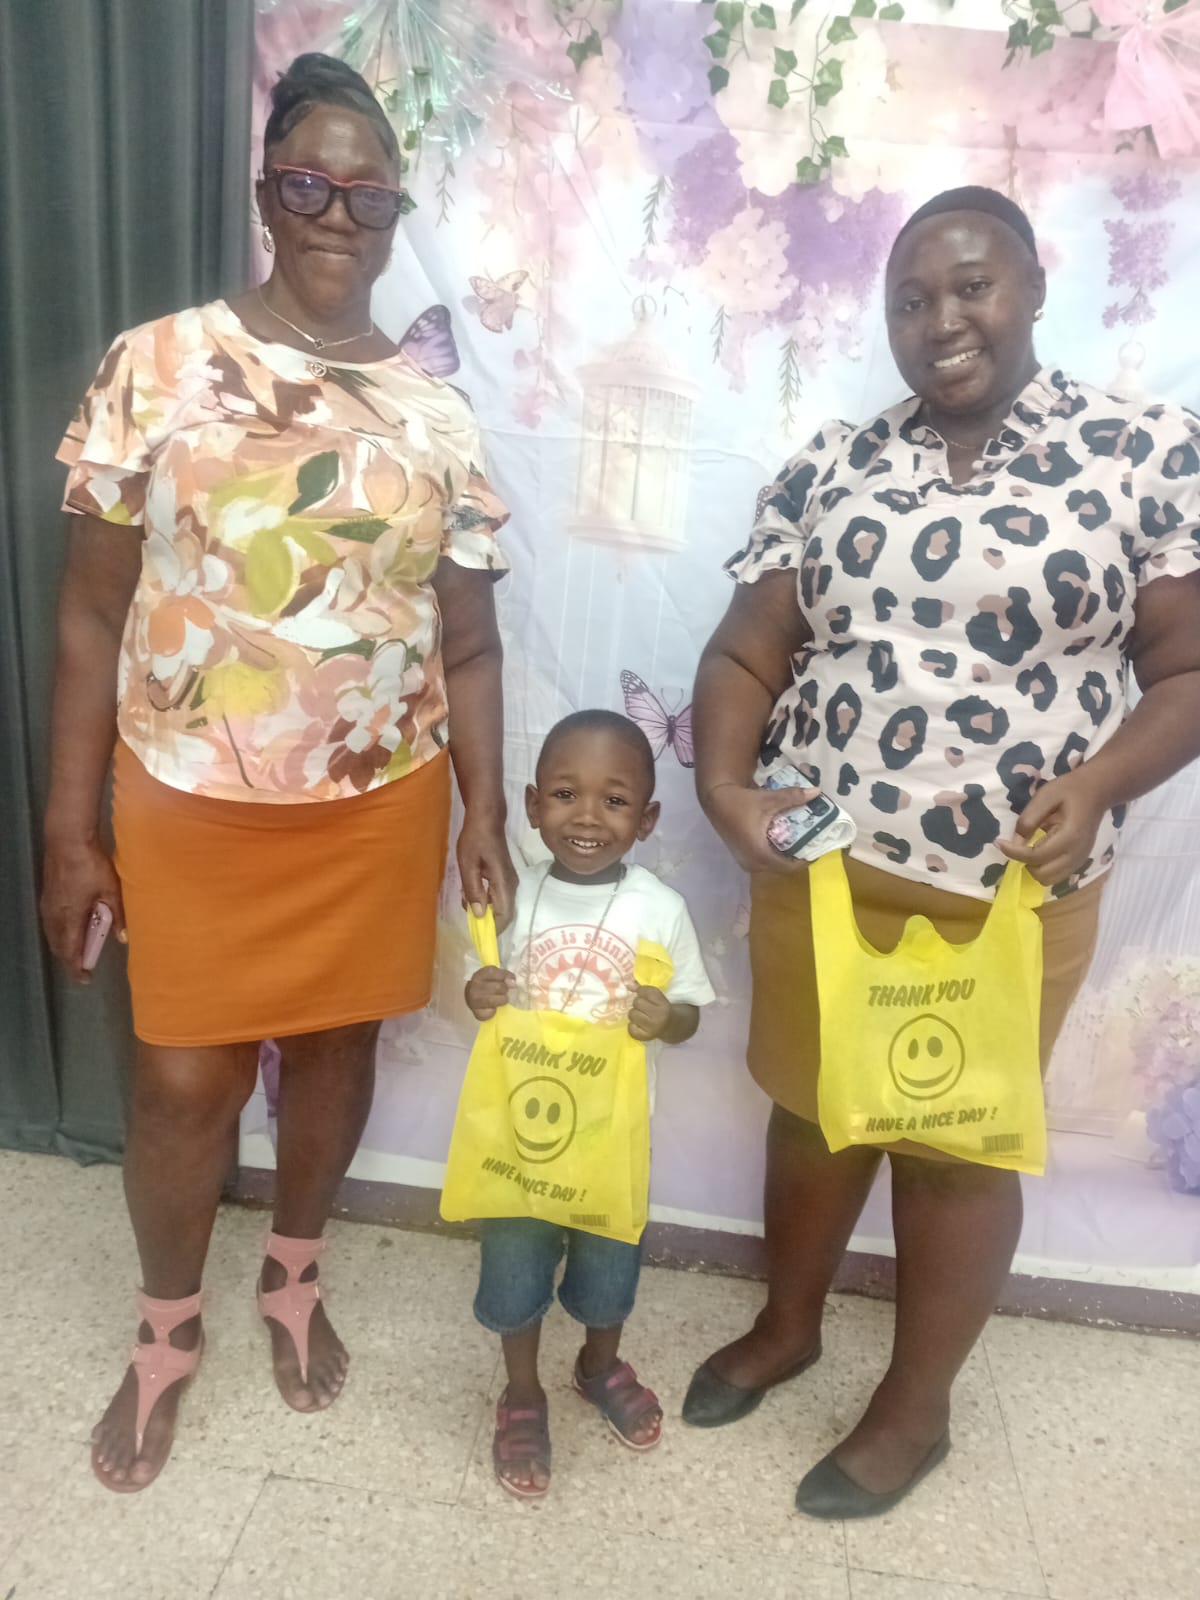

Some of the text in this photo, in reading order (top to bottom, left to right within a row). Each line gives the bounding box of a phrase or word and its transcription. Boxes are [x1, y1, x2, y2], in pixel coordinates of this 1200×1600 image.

[561, 930, 577, 945] is
[868, 978, 976, 1007] THANK YOU
[500, 1037, 607, 1077] THANK YOU
[865, 1117, 903, 1133] HAVE
[906, 1117, 917, 1131] A
[921, 1111, 954, 1130] NICE
[957, 1107, 988, 1125] DAY
[482, 1157, 516, 1180] HAVE
[522, 1176, 549, 1196] NICE
[550, 1183, 577, 1202] DAY
